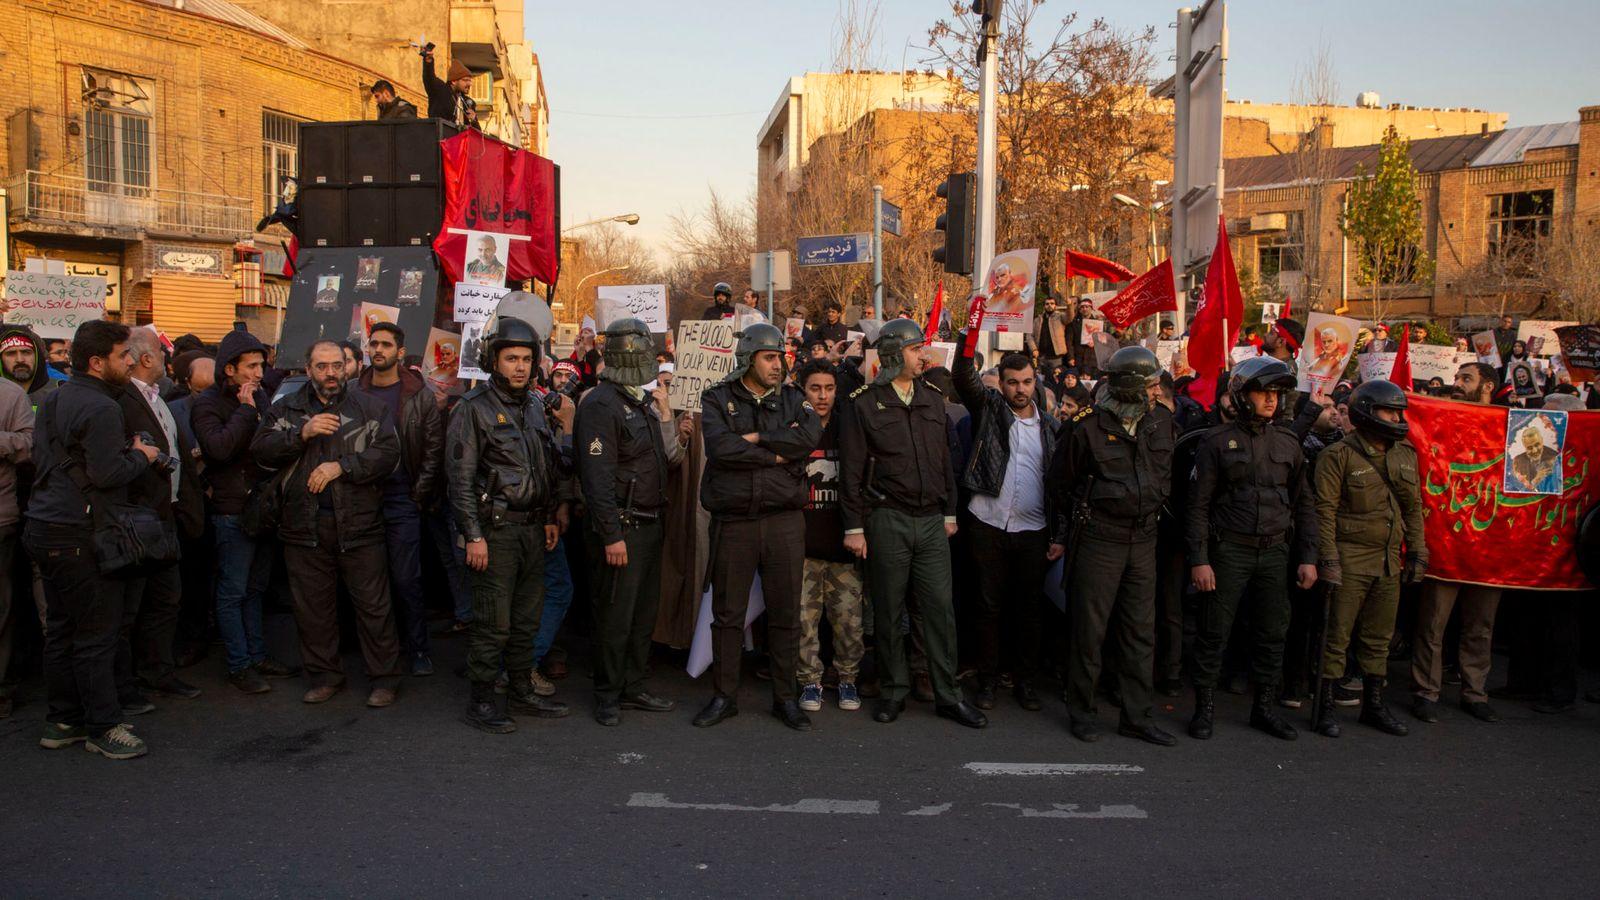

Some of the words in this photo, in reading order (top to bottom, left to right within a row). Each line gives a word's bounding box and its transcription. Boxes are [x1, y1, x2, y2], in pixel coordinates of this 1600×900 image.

[806, 240, 852, 258] فردوسی
[680, 322, 700, 344] THE
[700, 321, 734, 349] BLOOD
[682, 352, 704, 371] OUR
[689, 376, 701, 391] TO
